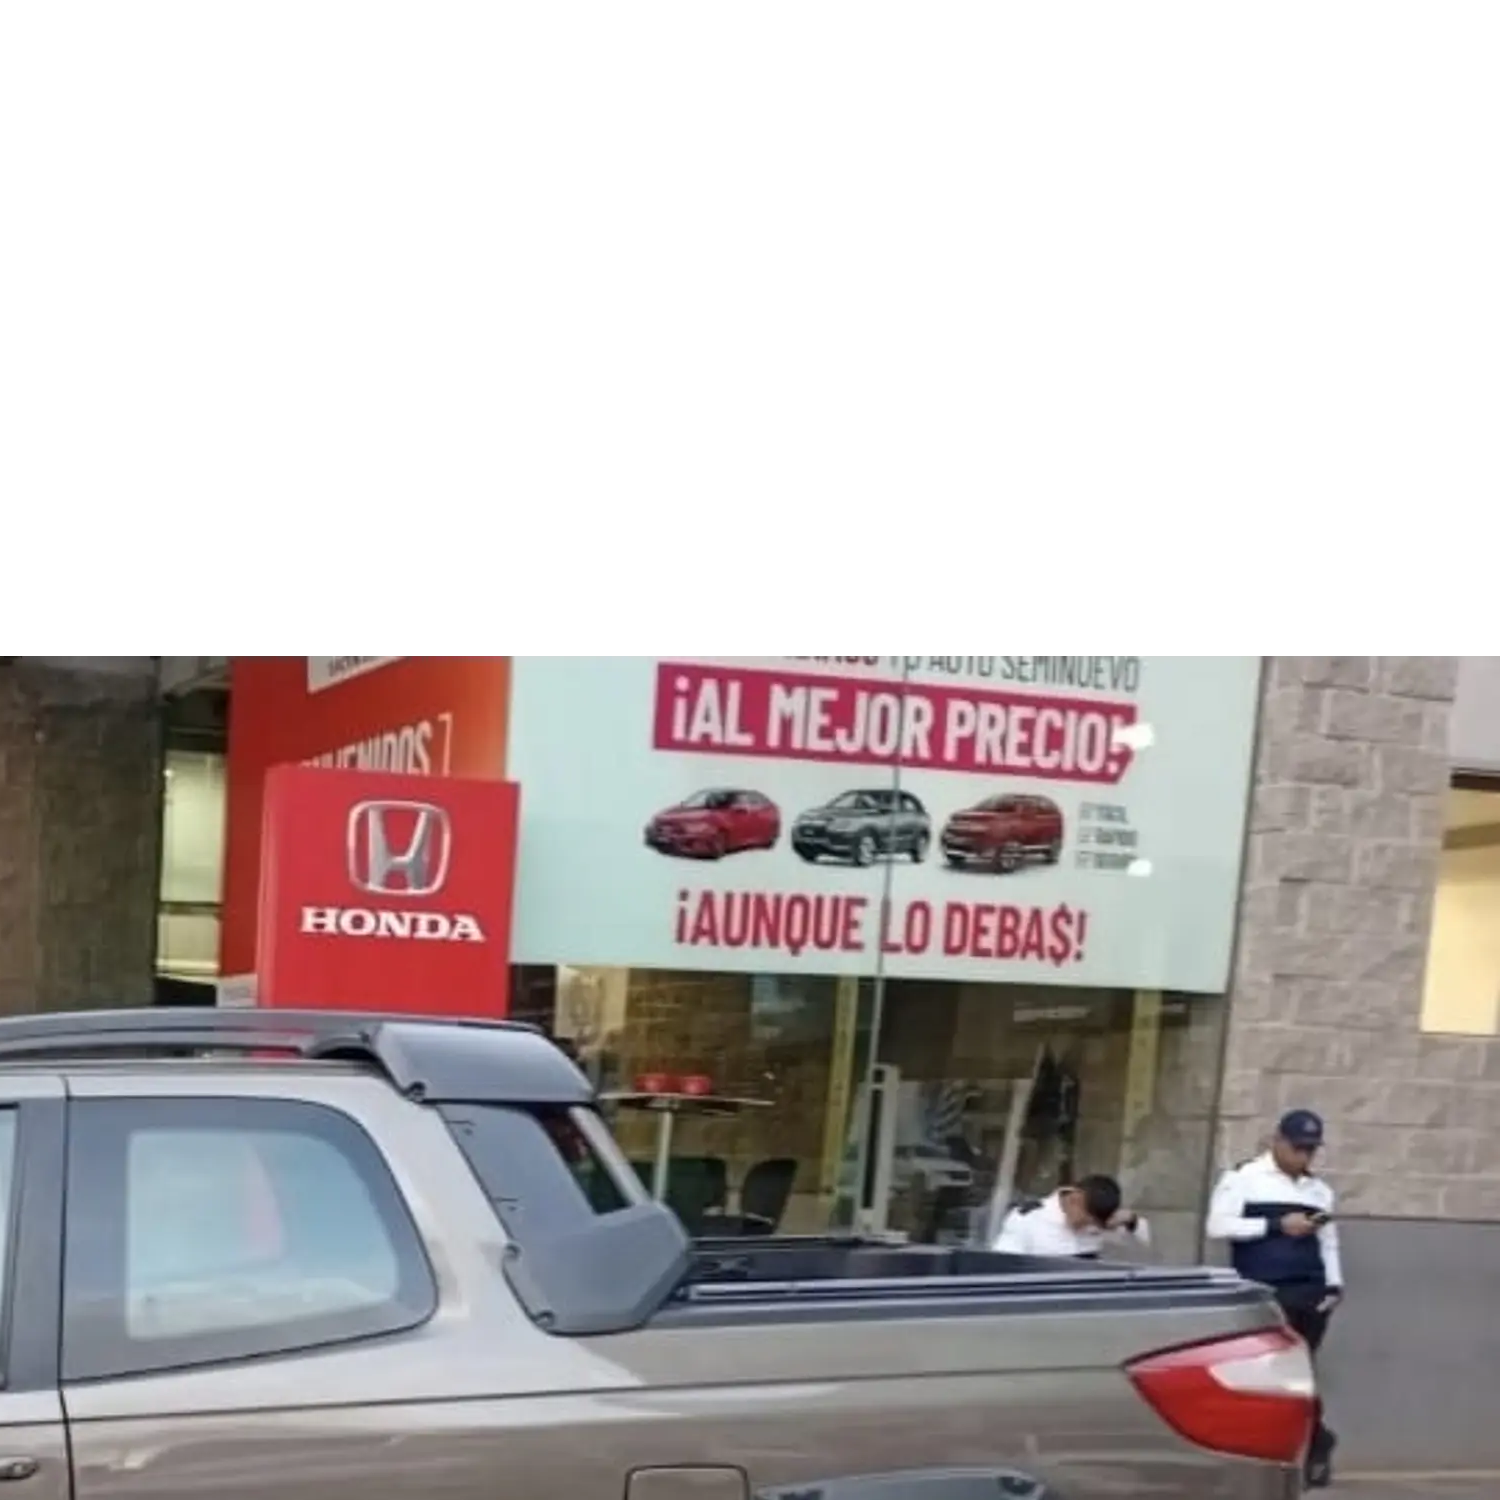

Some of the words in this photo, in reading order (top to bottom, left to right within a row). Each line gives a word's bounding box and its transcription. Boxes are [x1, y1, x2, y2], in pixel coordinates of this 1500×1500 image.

[767, 683, 931, 759] MEJOR
[944, 697, 1126, 775] PRECIO!
[301, 906, 486, 943] HONDA
[675, 889, 867, 956] ¡AUNQUE
[880, 898, 932, 954] LO
